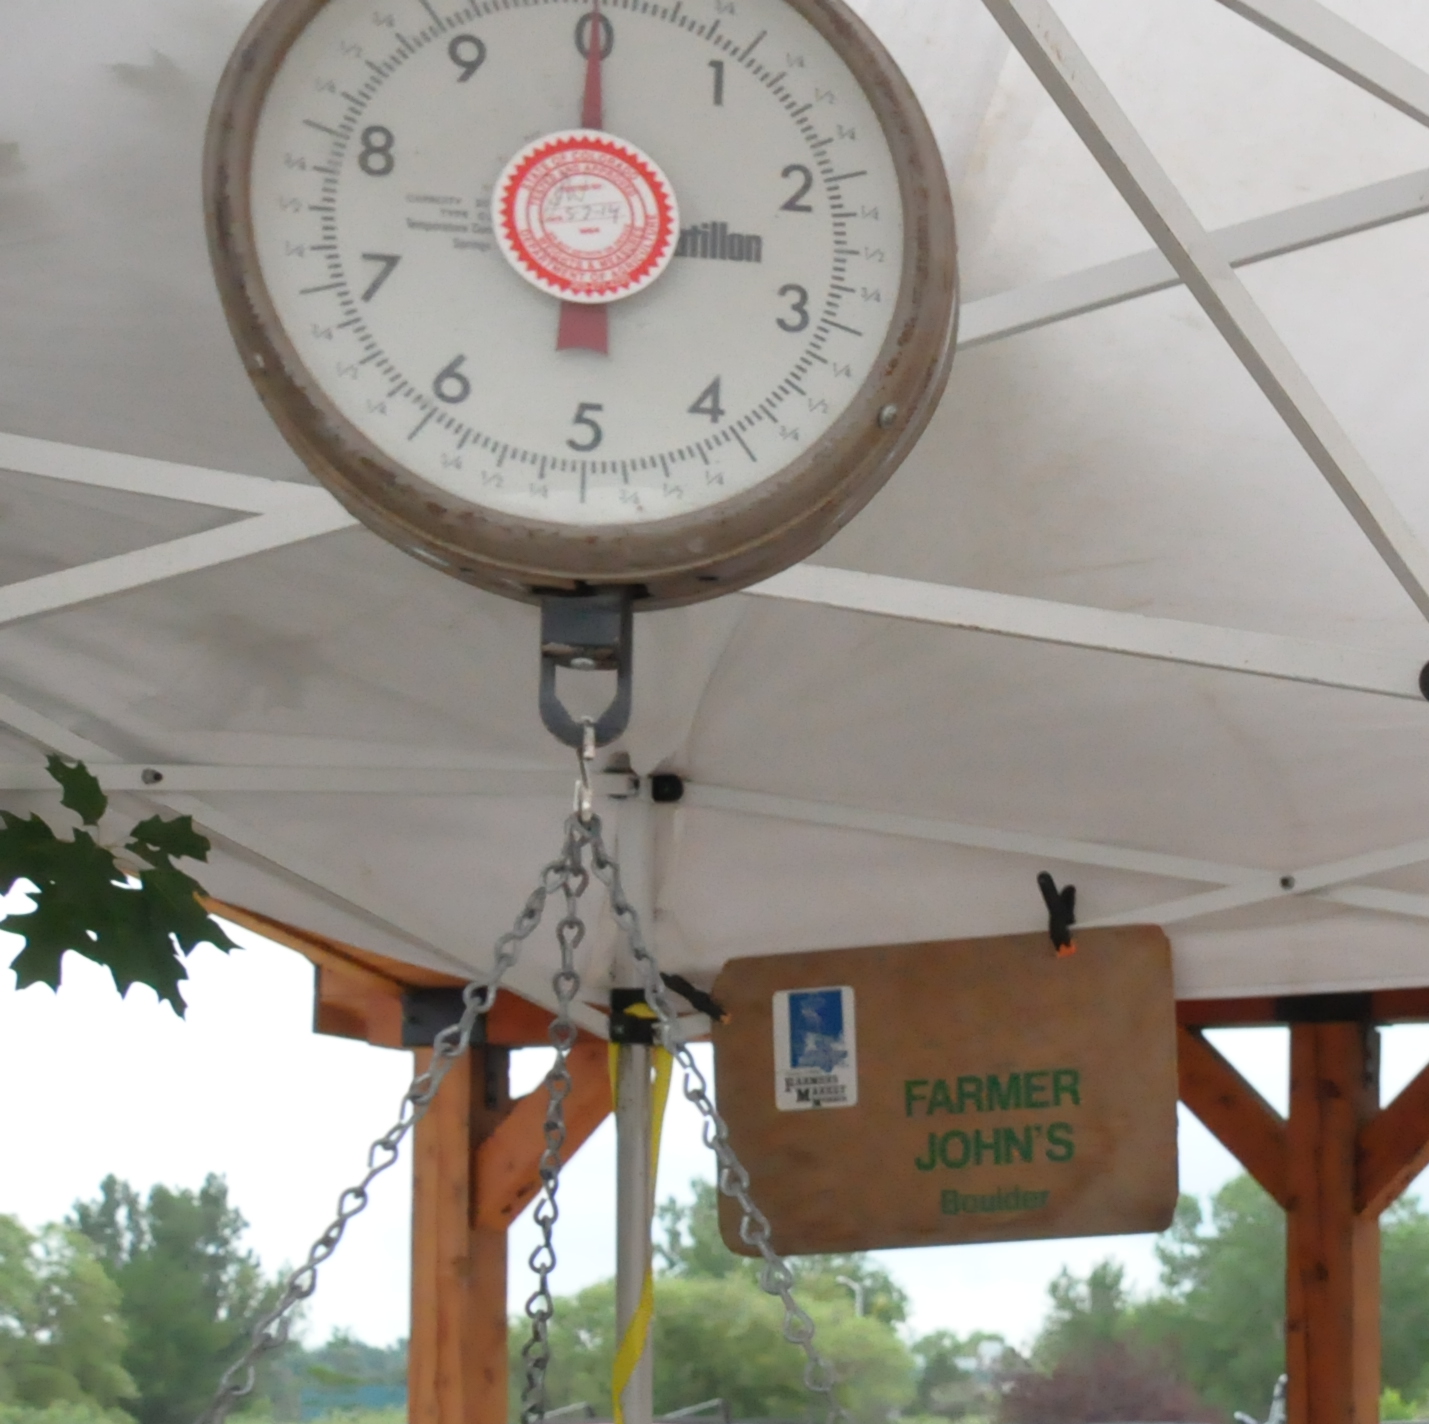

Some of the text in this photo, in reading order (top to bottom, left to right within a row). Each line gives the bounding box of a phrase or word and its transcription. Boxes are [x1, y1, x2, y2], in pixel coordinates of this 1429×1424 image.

[448, 34, 487, 83] 9
[575, 13, 614, 61] 0
[707, 60, 725, 106] 1
[358, 125, 395, 177] 8
[780, 164, 813, 212] 2
[361, 252, 401, 302] 7
[776, 283, 810, 332] 3
[432, 354, 471, 404] 6
[687, 374, 726, 424] 4
[566, 402, 604, 452] 5
[904, 1067, 1082, 1118] FARMER
[914, 1122, 1077, 1172] JOHN'S
